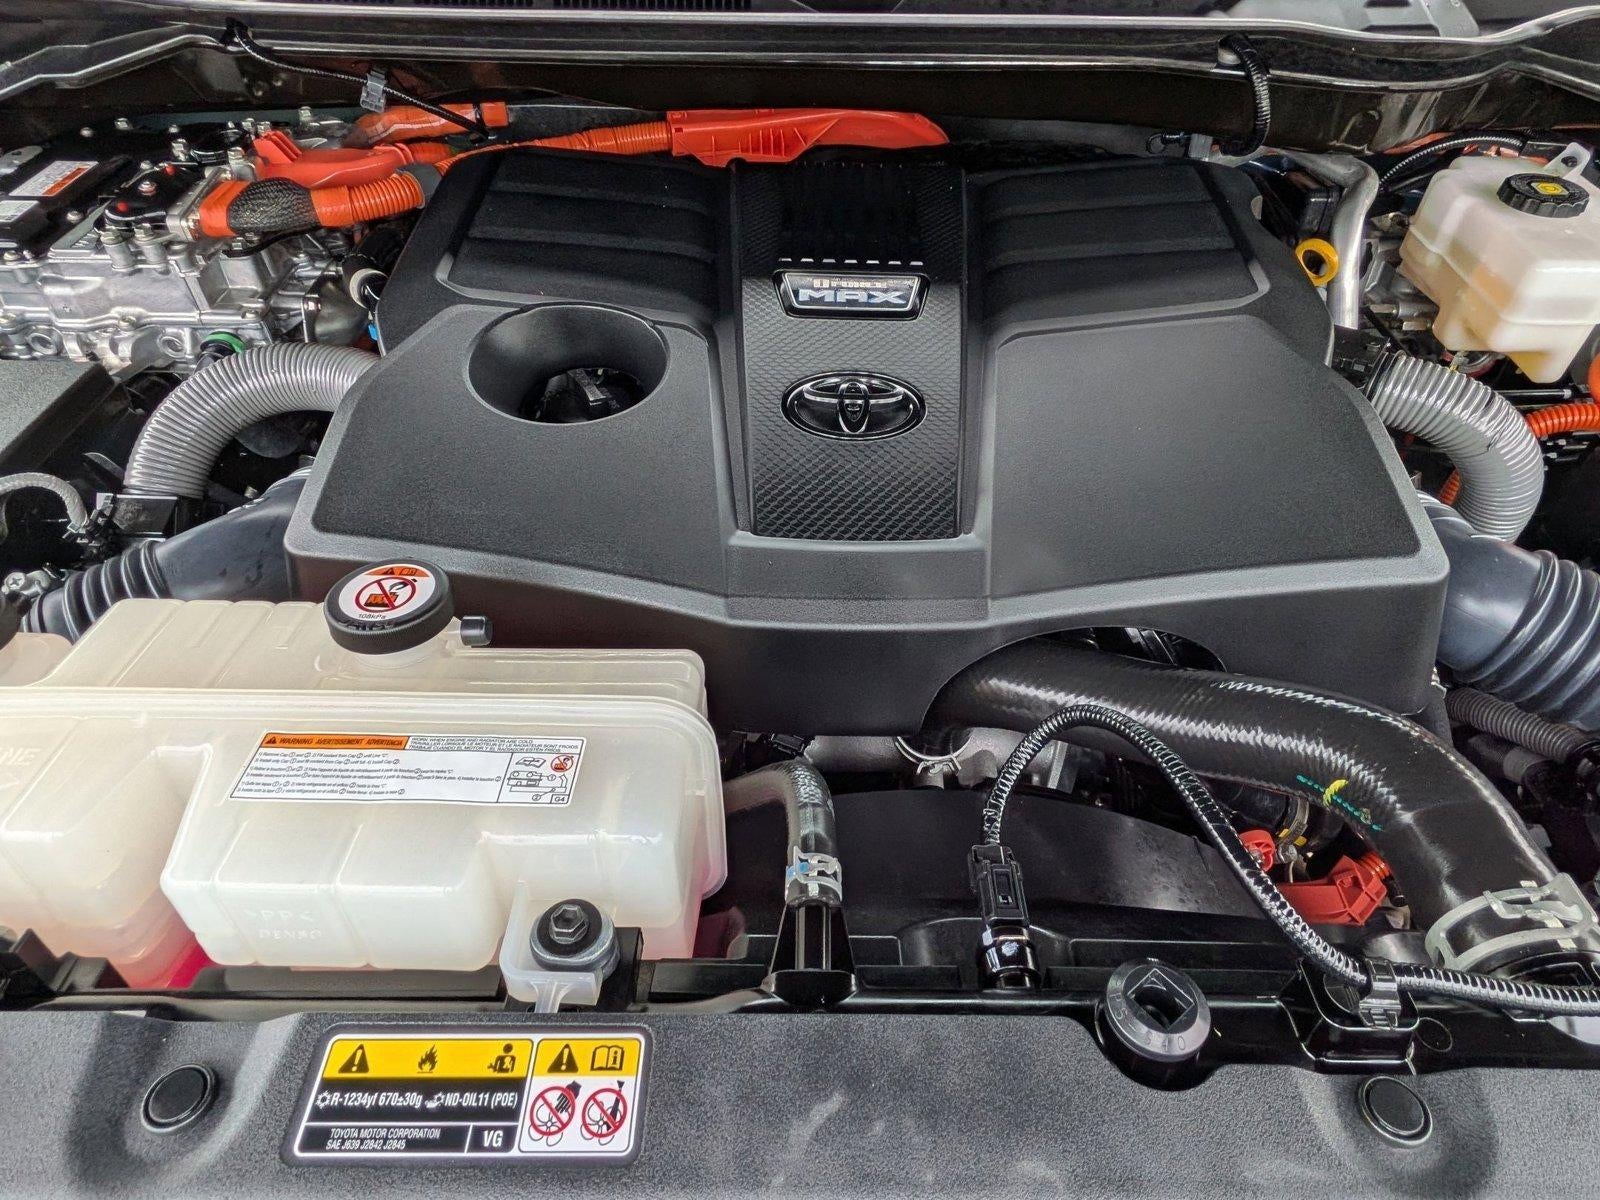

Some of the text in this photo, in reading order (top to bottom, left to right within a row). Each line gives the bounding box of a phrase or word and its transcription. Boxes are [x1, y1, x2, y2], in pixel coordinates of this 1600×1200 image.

[798, 288, 906, 304] MAX
[279, 737, 314, 745] WARNING
[330, 1092, 376, 1108] R-1234yf
[379, 1092, 422, 1108] 670±30g
[490, 1092, 518, 1108] (POE)
[326, 1139, 406, 1150] SAE J639 J2842 J2845
[330, 1128, 504, 1148] TOYOTA MOTOR CORPORATION VG
